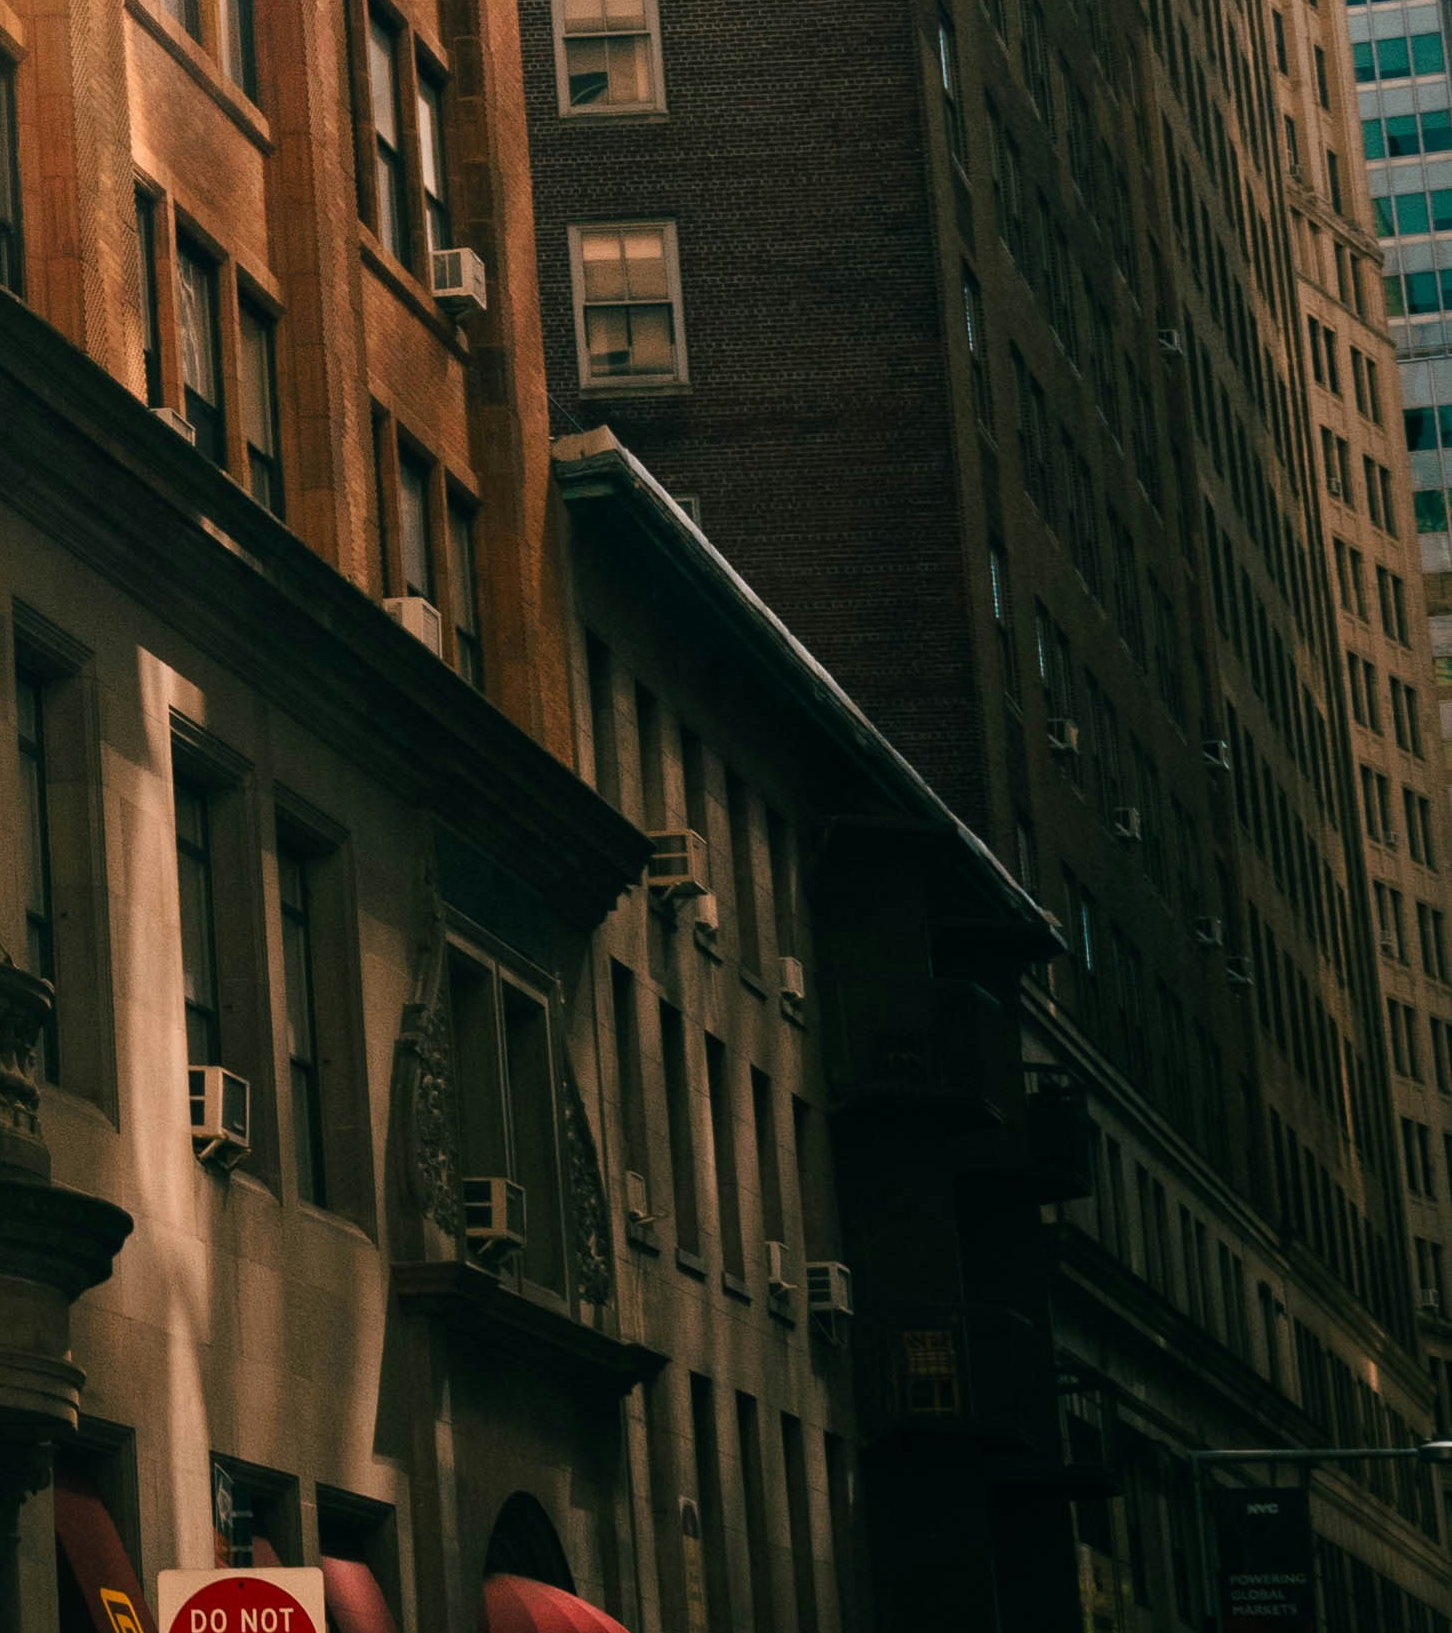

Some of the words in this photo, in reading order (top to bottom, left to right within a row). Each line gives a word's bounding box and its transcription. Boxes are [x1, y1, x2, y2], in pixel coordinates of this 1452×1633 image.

[1247, 1503, 1279, 1515] NYC
[1230, 1573, 1308, 1586] POWERING
[1231, 1588, 1287, 1602] GLOBAL
[1232, 1603, 1298, 1616] MARKETS
[190, 1607, 228, 1633] DO
[240, 1606, 295, 1633] NOT
